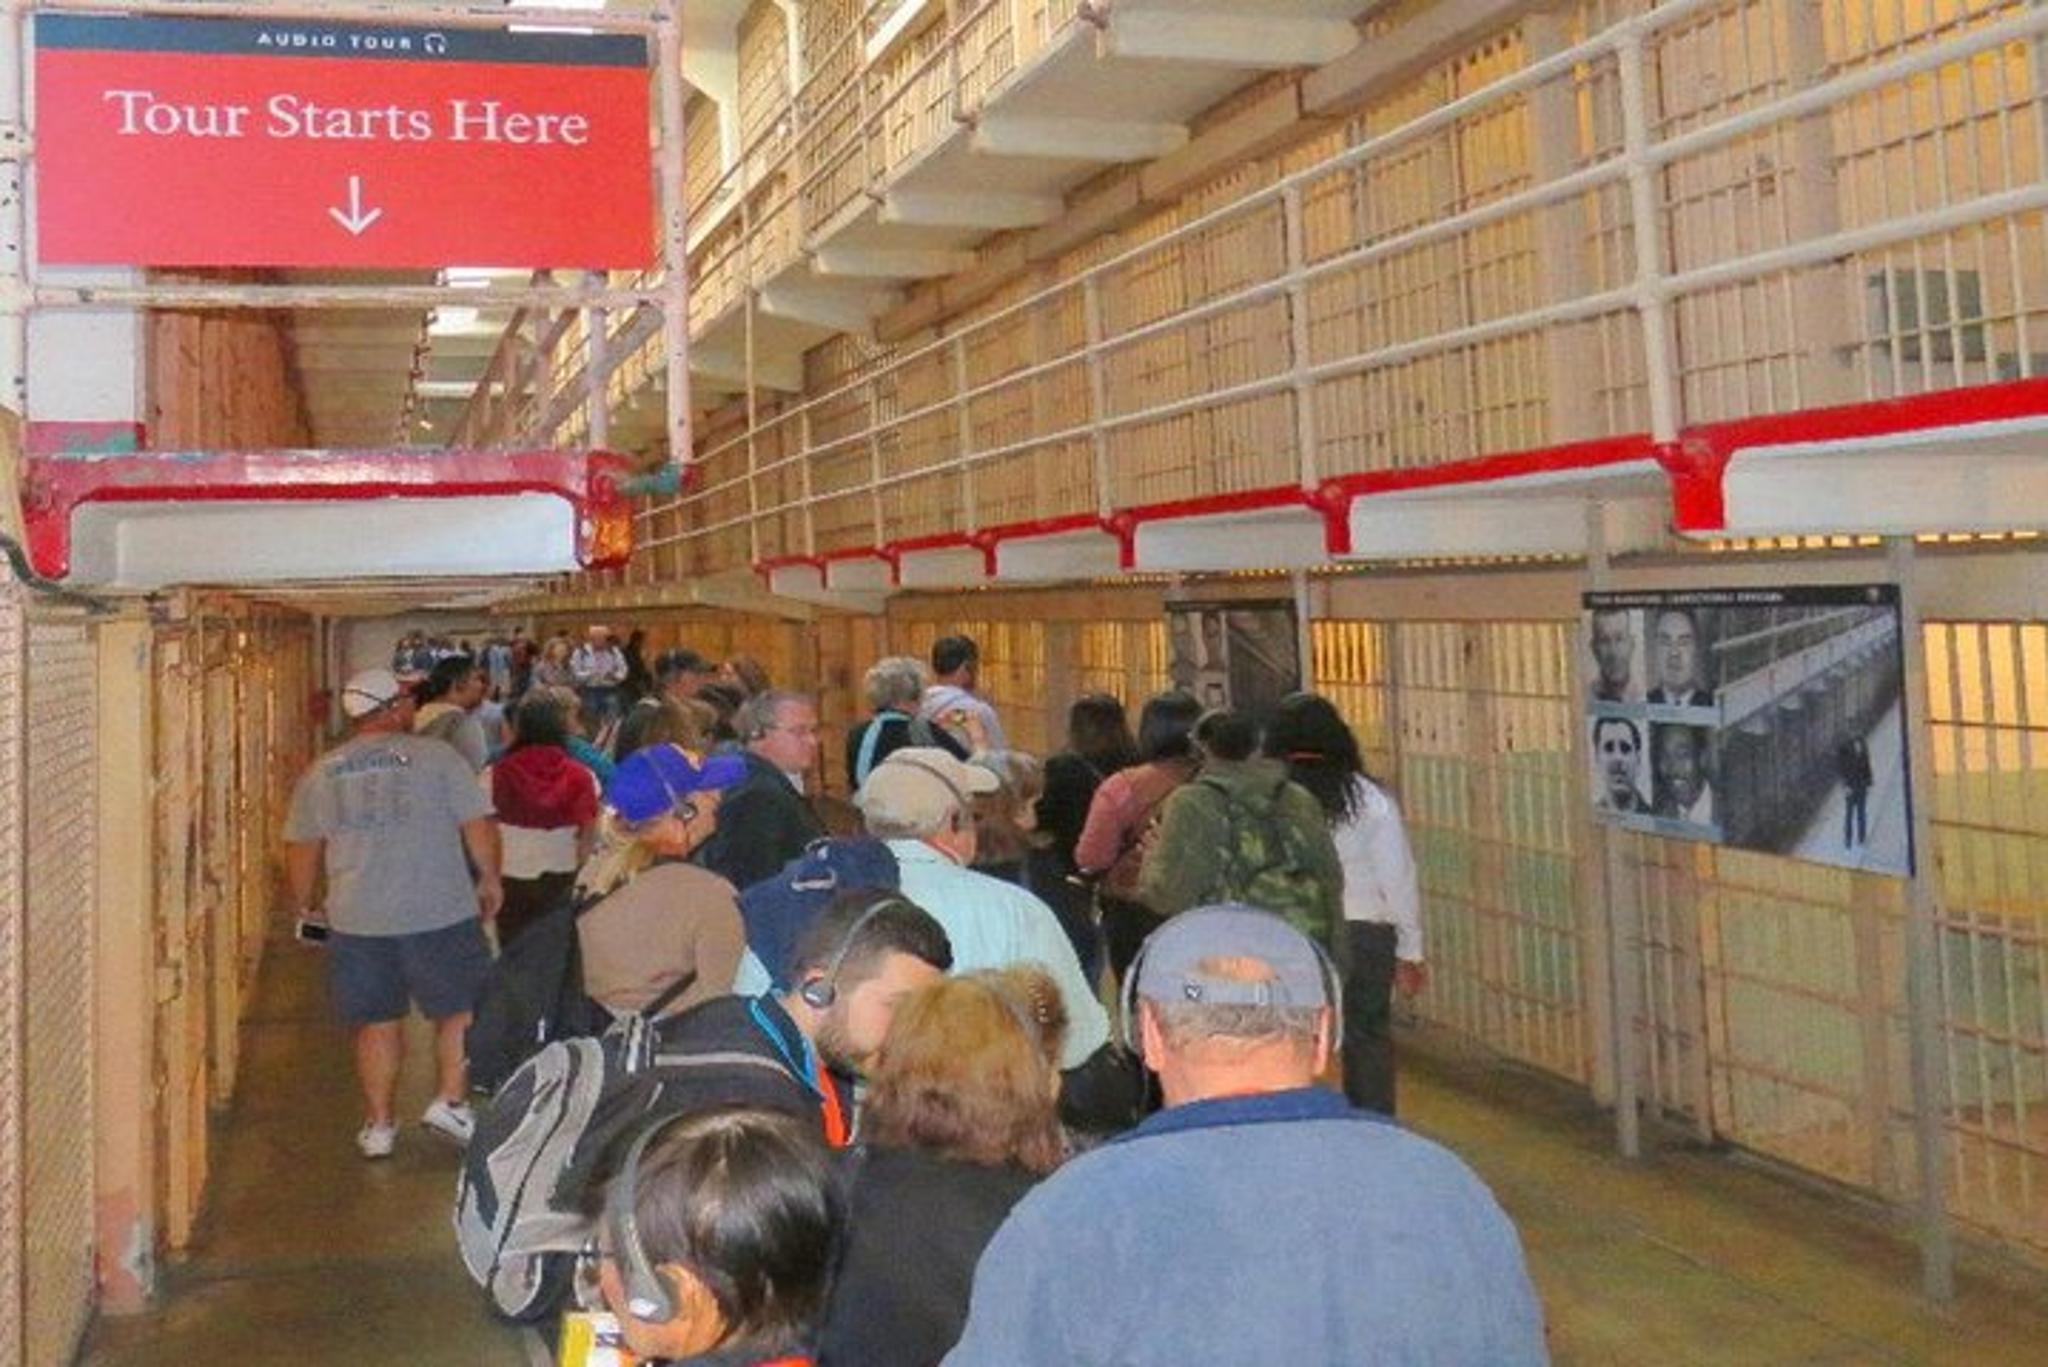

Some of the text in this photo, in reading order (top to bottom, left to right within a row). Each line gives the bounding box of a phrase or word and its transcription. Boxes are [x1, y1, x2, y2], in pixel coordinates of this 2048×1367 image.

[257, 33, 411, 49] AUDIO TOUR
[104, 90, 589, 145] Tour Starts Here
